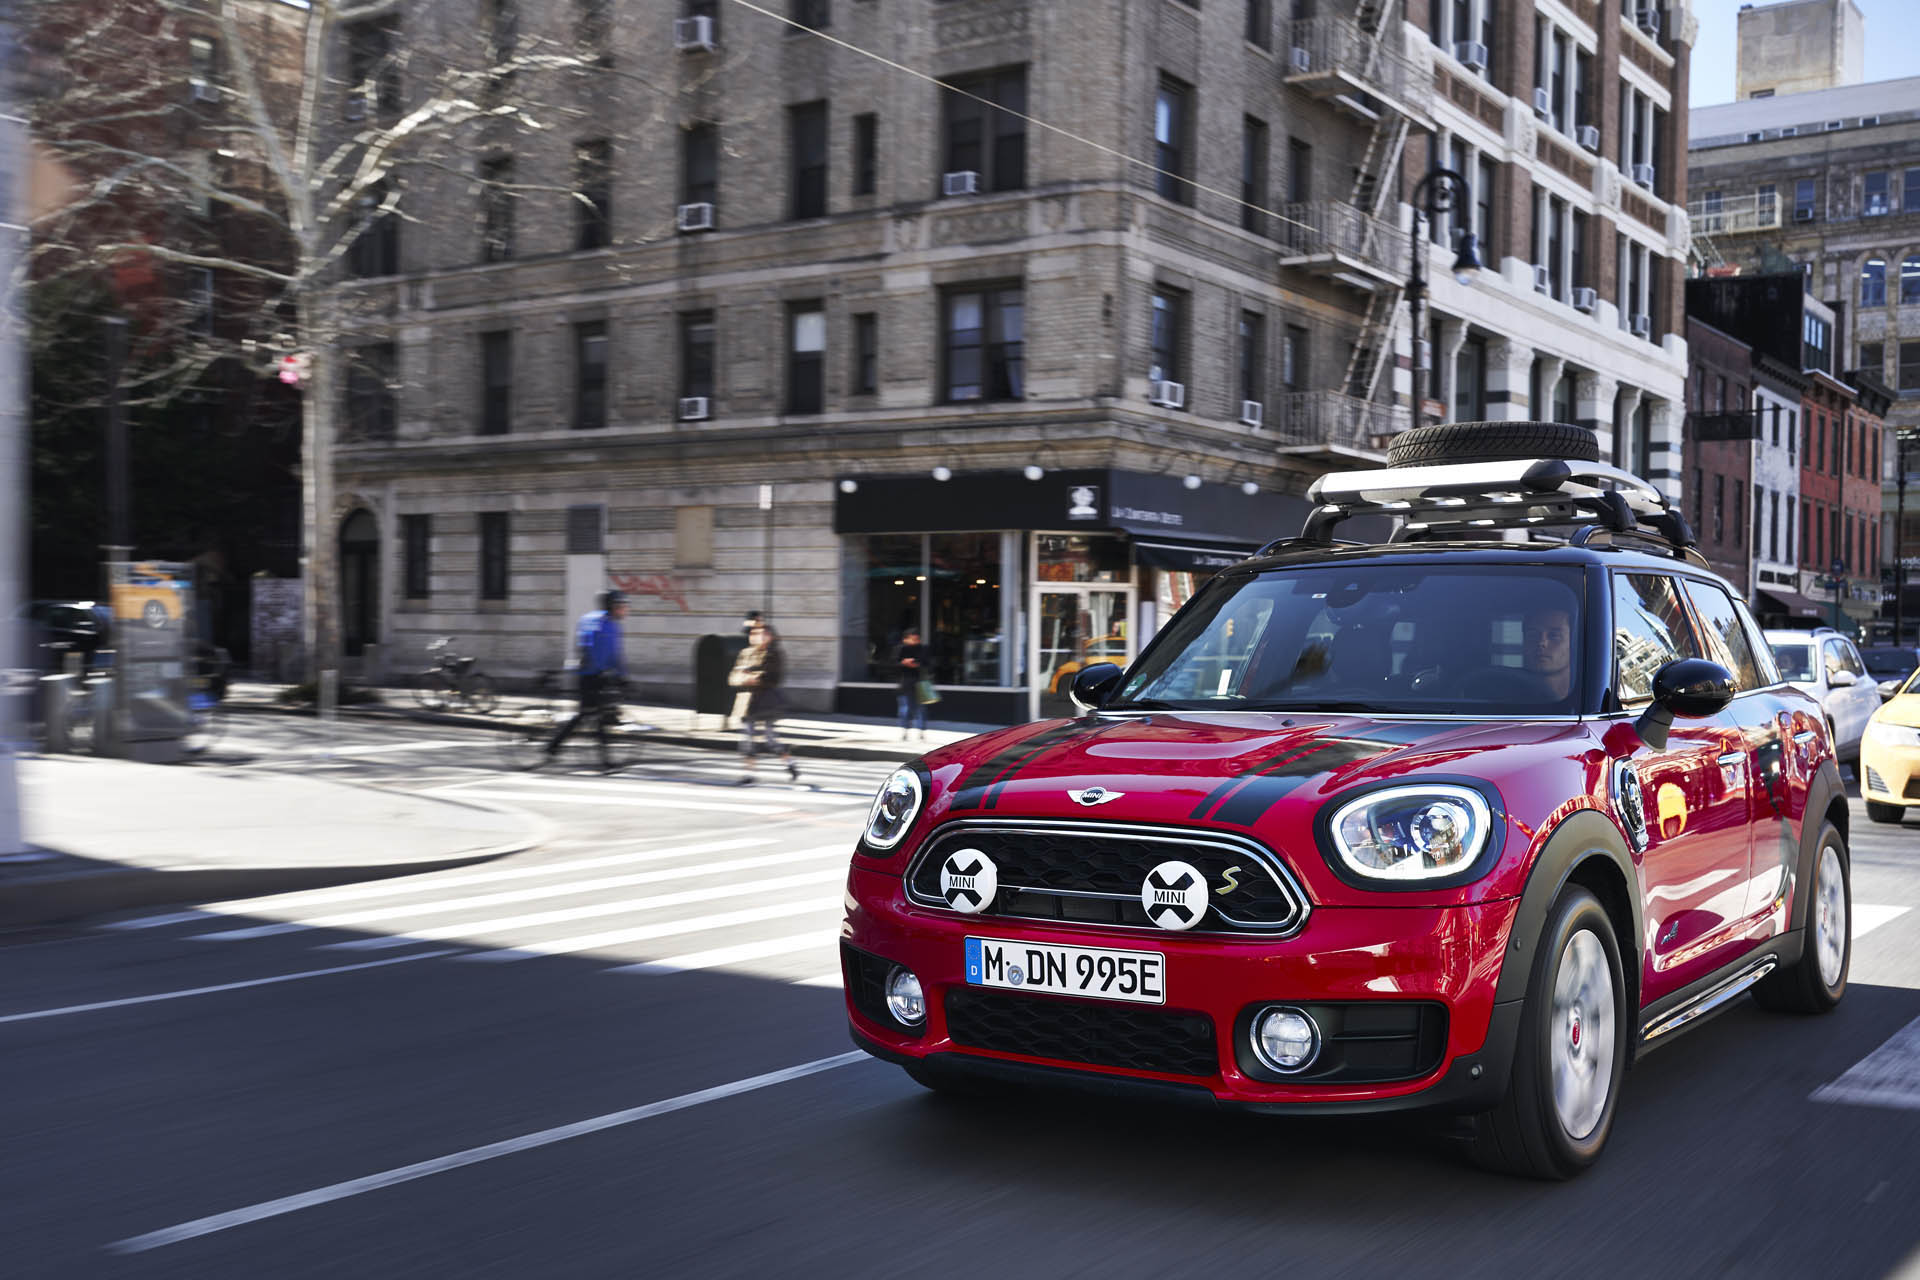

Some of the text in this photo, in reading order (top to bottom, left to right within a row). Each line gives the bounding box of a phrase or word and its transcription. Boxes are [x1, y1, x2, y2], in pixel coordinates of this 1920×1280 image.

[950, 876, 975, 889] MINI
[1215, 866, 1241, 895] S
[1154, 890, 1185, 904] MINI
[970, 965, 978, 976] D
[1025, 949, 1067, 988] DN
[1076, 954, 1161, 997] 995E
